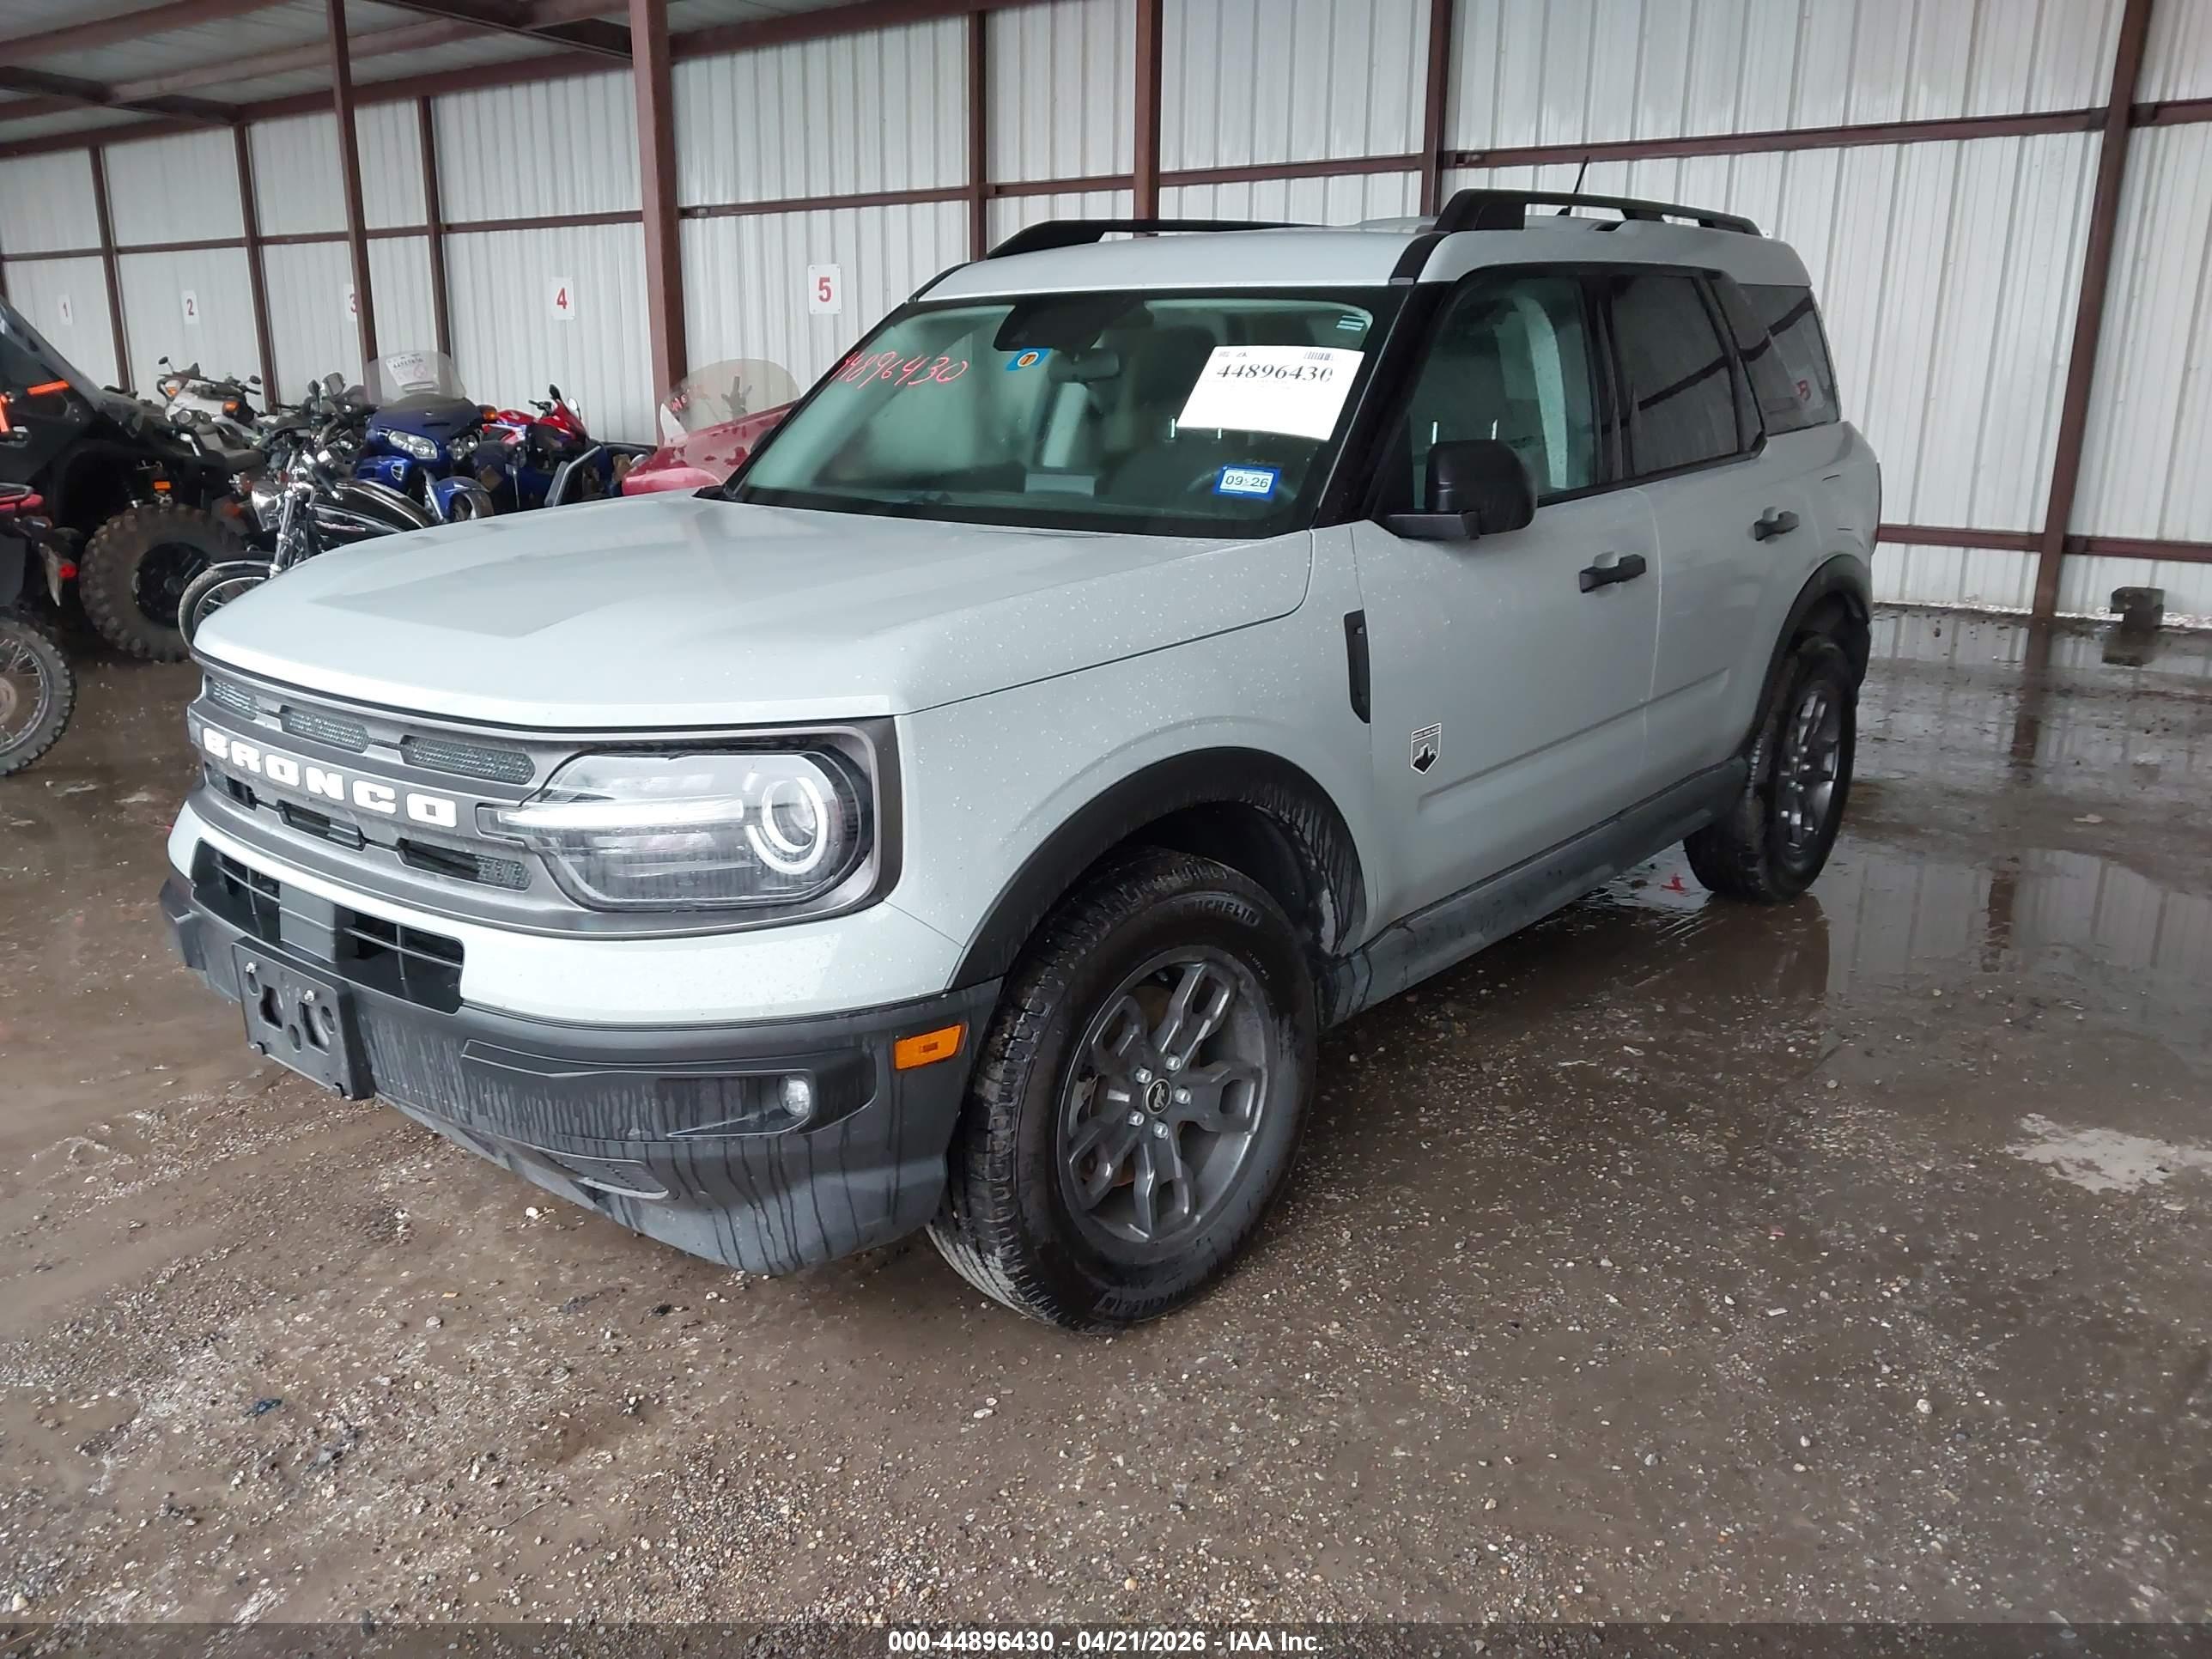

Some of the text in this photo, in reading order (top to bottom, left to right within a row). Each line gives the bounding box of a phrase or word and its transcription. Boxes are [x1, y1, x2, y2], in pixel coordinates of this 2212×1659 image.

[556, 288, 568, 309] 4
[818, 276, 831, 302] 5
[63, 302, 69, 317] 1
[186, 299, 194, 315] 2
[1216, 363, 1334, 383] 44896430
[1250, 477, 1270, 488] 26
[203, 727, 457, 828] BRONCO
